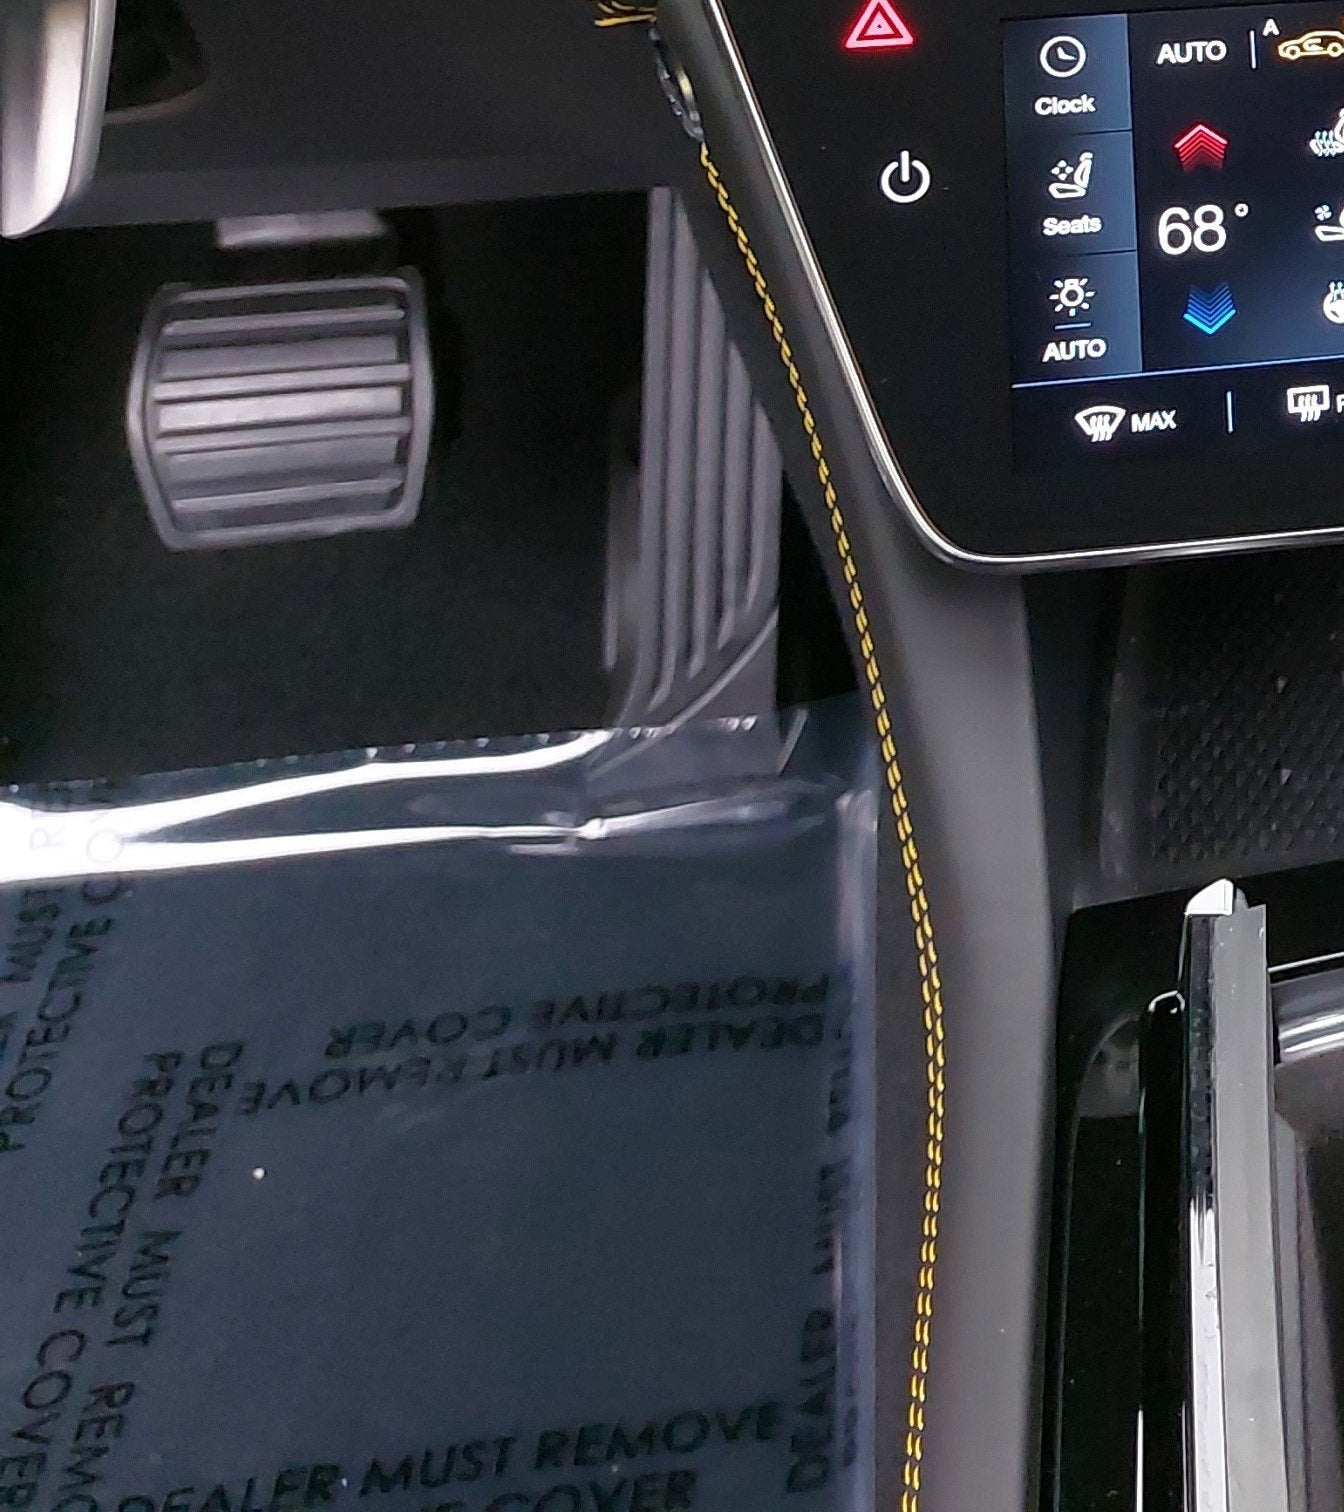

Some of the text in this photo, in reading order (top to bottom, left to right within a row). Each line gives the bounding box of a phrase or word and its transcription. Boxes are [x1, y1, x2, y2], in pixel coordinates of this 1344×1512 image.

[1262, 19, 1280, 36] A
[1156, 40, 1228, 65] AUTO
[1034, 94, 1097, 116] Clock
[1042, 214, 1102, 236] Seats
[1042, 338, 1107, 363] AUTO
[1130, 409, 1178, 433] MAX
[322, 1003, 513, 1061] COVER
[154, 1038, 247, 1204] DEALER
[53, 1048, 184, 1316] PROTECTIVE
[104, 1228, 183, 1350] MUST
[357, 1434, 518, 1499] MUST
[533, 1398, 787, 1472] REMOVE
